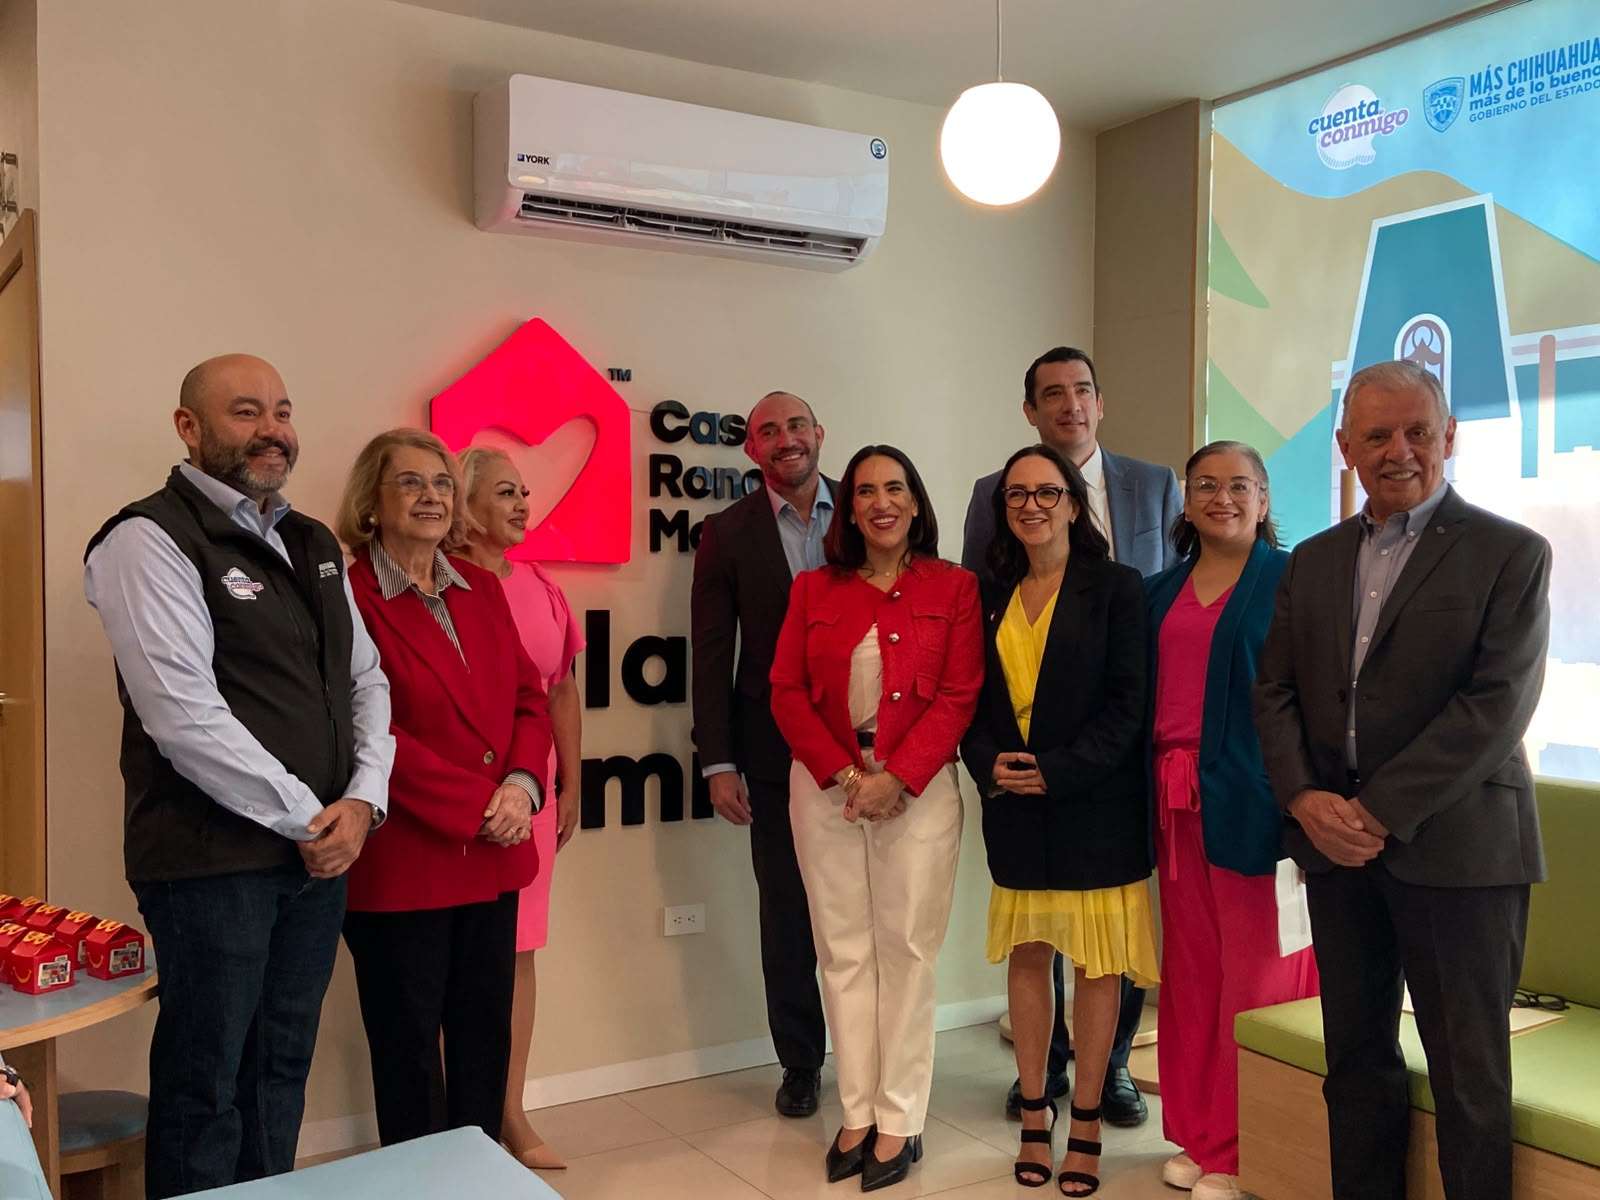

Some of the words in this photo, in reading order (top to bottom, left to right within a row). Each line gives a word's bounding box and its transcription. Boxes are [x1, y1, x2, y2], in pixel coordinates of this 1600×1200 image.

[1469, 92, 1501, 111] más
[1505, 86, 1525, 101] de
[1530, 80, 1545, 94] lo
[1550, 65, 1600, 88] bueno
[1470, 64, 1503, 97] MÁS
[1508, 37, 1600, 86] CHIHUAHUA
[1308, 99, 1380, 135] cuenta
[1469, 100, 1527, 122] GOBIERNO
[1531, 93, 1552, 106] DEL
[1555, 79, 1600, 99] ESTADO
[1320, 109, 1409, 148] conmigo
[526, 154, 550, 165] YORK
[650, 400, 747, 446] Cas
[650, 454, 764, 500] Ron
[571, 609, 687, 708] la
